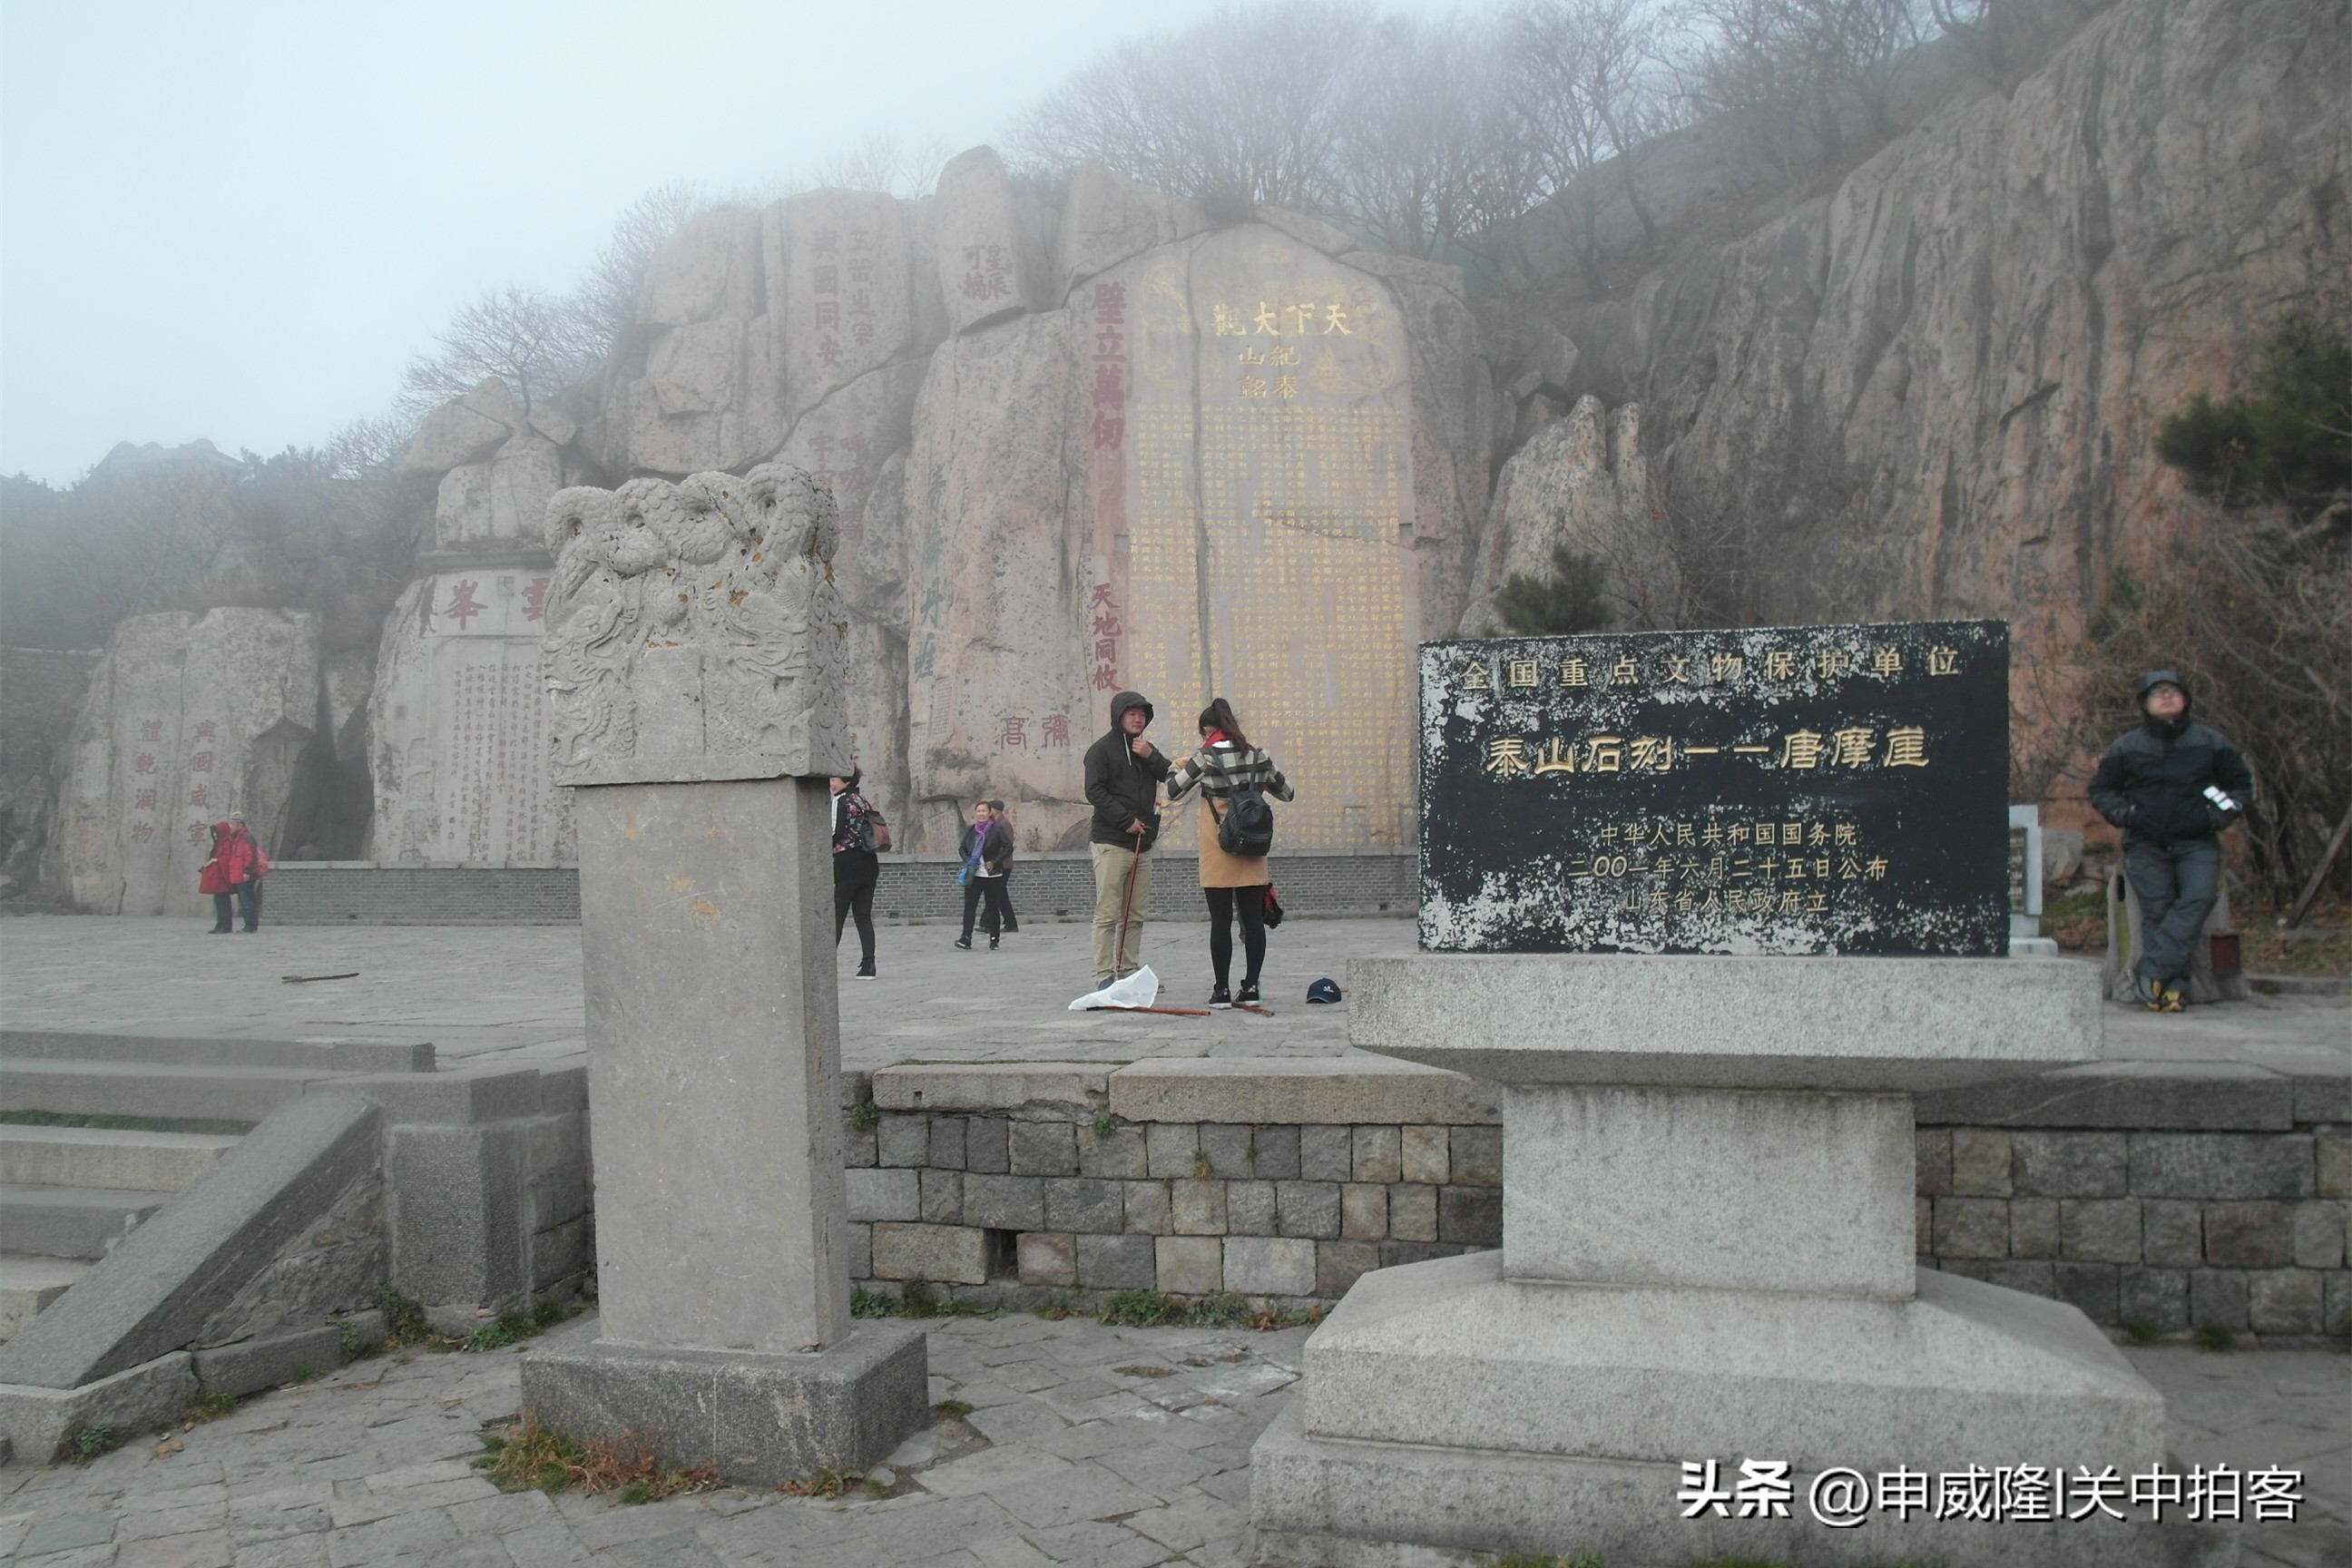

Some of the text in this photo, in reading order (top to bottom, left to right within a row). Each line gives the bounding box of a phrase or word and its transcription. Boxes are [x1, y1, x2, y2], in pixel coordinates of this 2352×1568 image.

[1460, 645, 1961, 691] 全国重点文物保护单位
[1600, 822, 1857, 848] 中华人民共和国国务院
[1625, 889, 1828, 912] 山东省人民政府立
